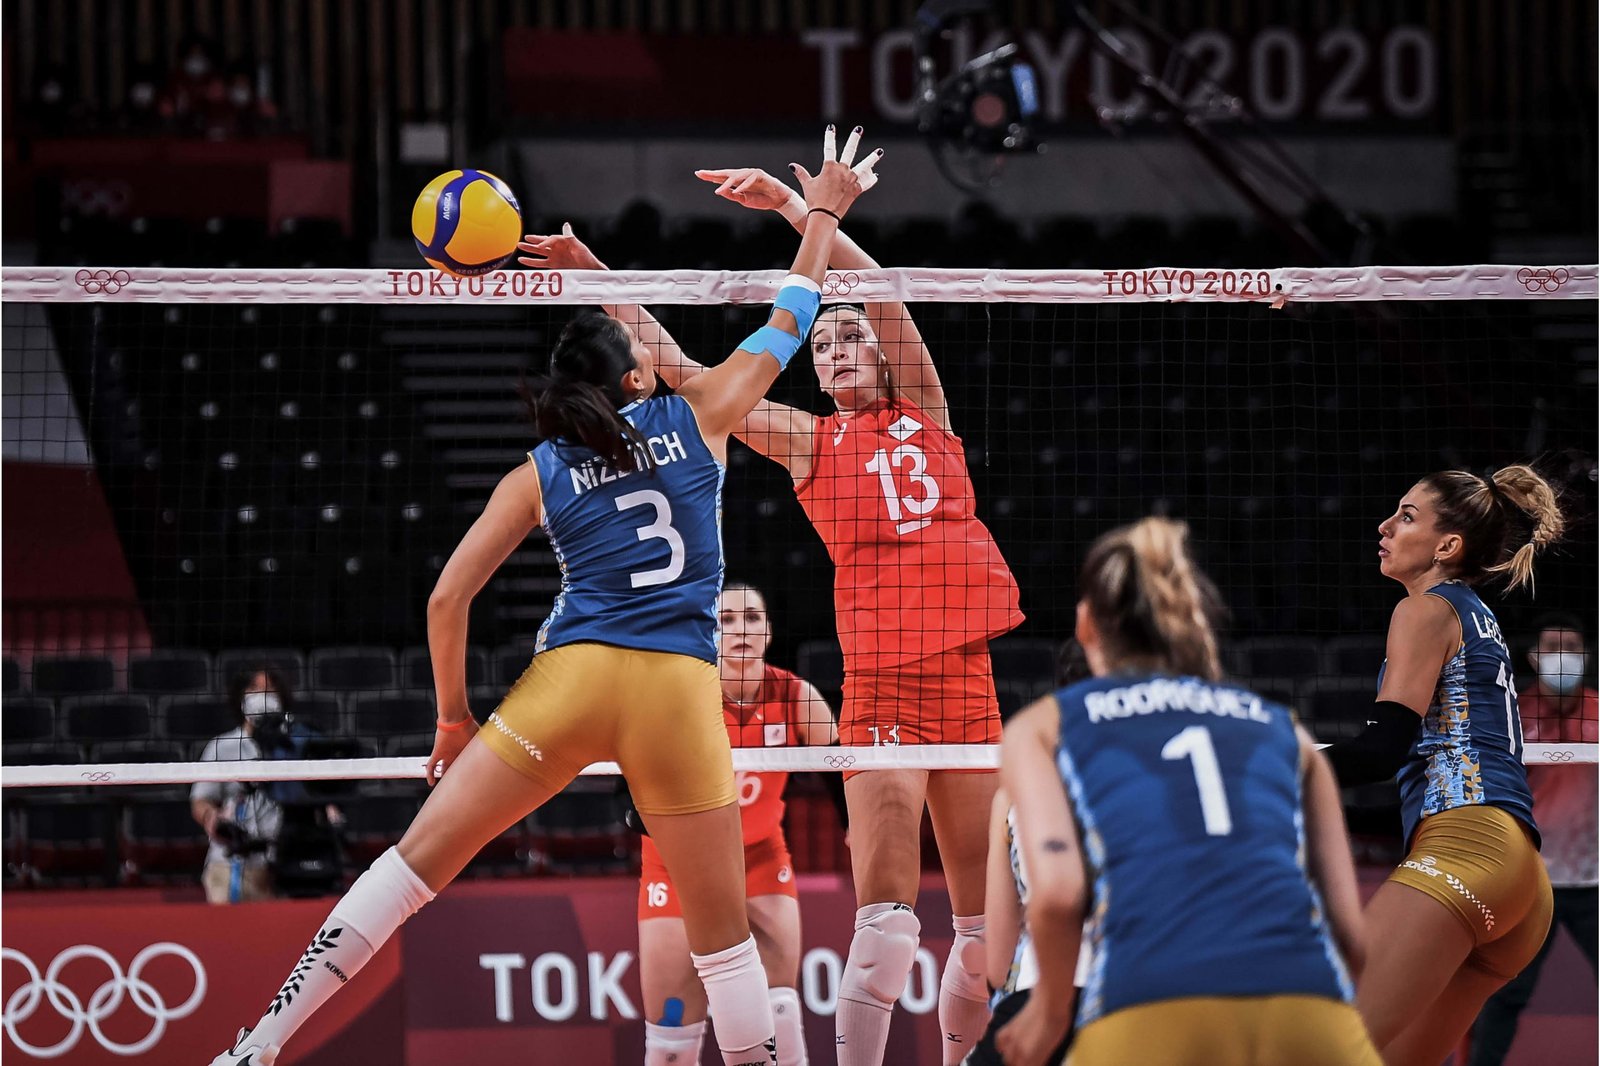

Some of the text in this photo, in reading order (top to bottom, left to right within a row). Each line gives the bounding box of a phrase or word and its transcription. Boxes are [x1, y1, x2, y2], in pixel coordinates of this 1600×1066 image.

[1186, 27, 1438, 120] 2020
[387, 271, 562, 297] TOKYO 2020
[1103, 269, 1271, 296] TOKYO 2020
[865, 444, 940, 520] 13
[614, 489, 685, 589] 3
[1084, 678, 1272, 724] RODRIGUEZ
[735, 771, 762, 808] 6
[1160, 726, 1233, 836] 1
[646, 882, 668, 907] 16
[479, 951, 712, 1022] TOK
